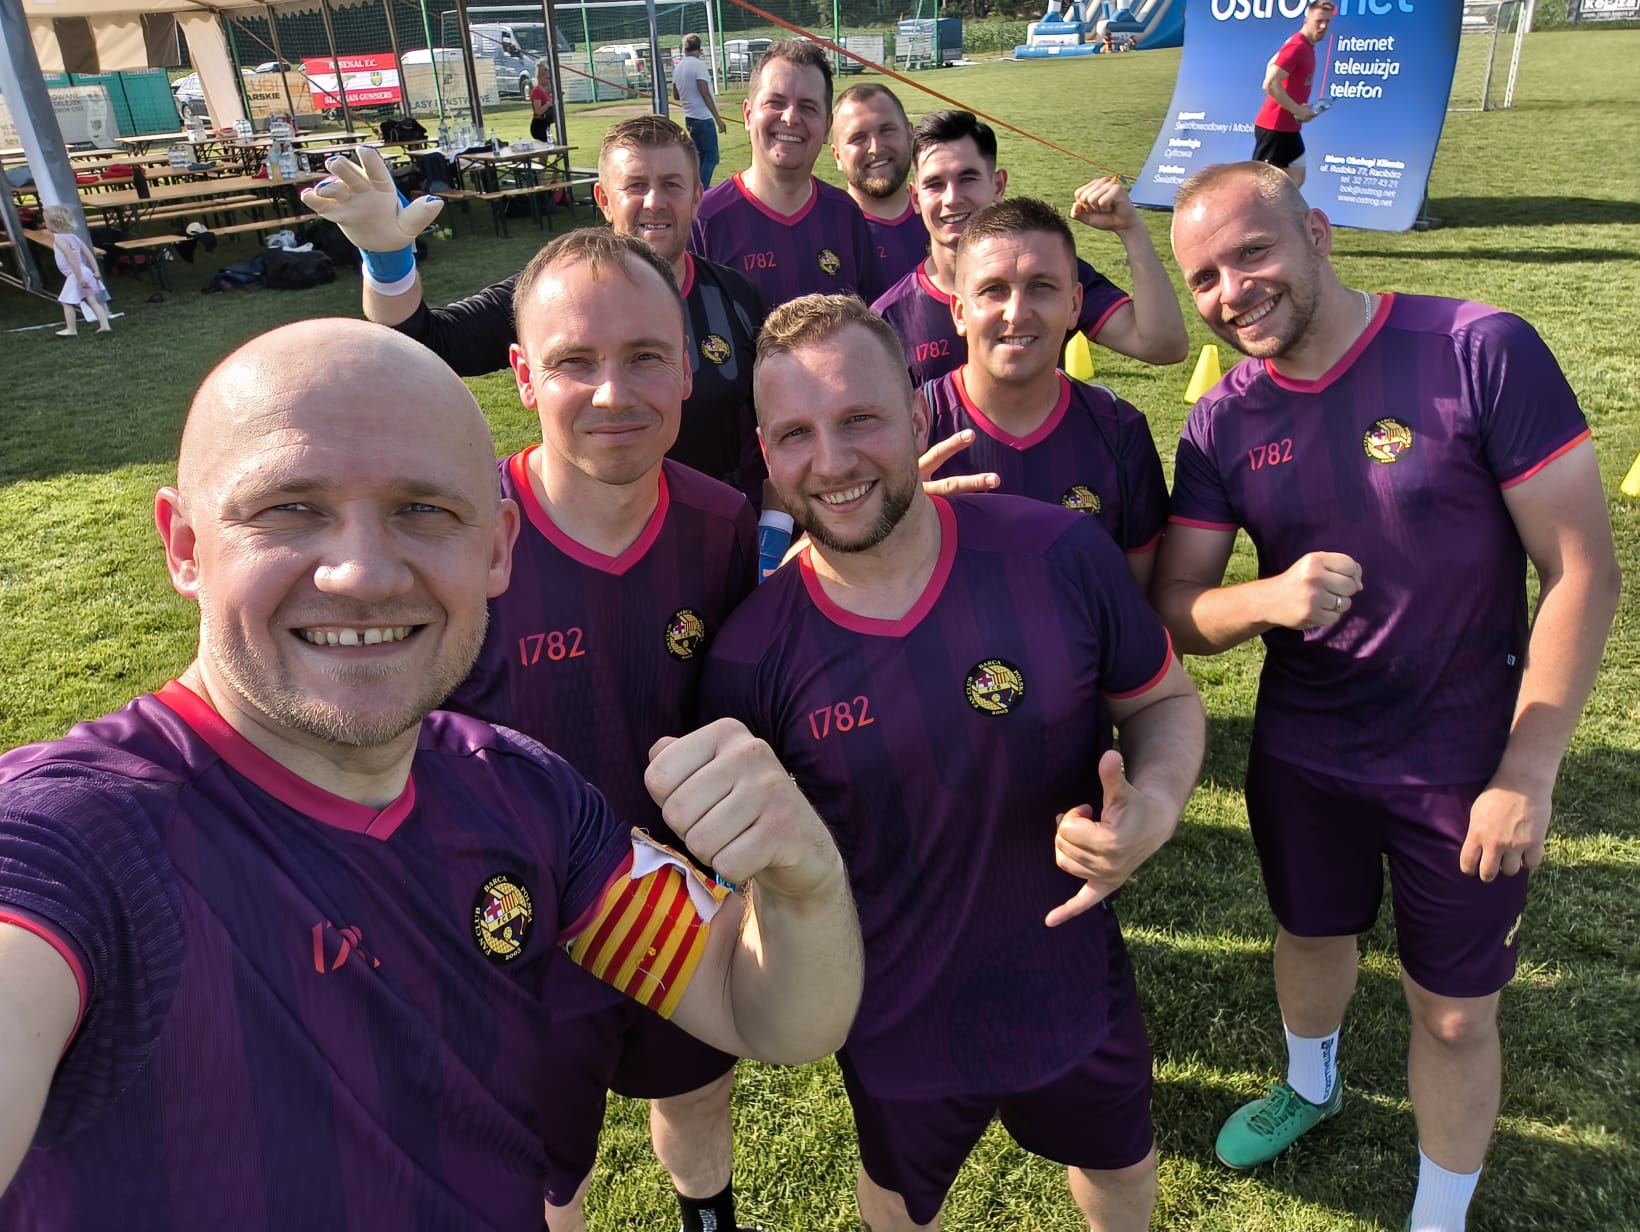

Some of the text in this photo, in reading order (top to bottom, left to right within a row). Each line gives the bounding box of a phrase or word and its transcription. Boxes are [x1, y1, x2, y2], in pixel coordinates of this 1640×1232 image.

[1337, 35, 1394, 52] internet
[1334, 60, 1400, 79] telewizja
[1330, 82, 1383, 99] telefon
[743, 251, 777, 271] 1782
[915, 339, 951, 362] 1782
[1249, 438, 1293, 471] 1782
[519, 626, 586, 667] 1782
[808, 695, 875, 740] 1782
